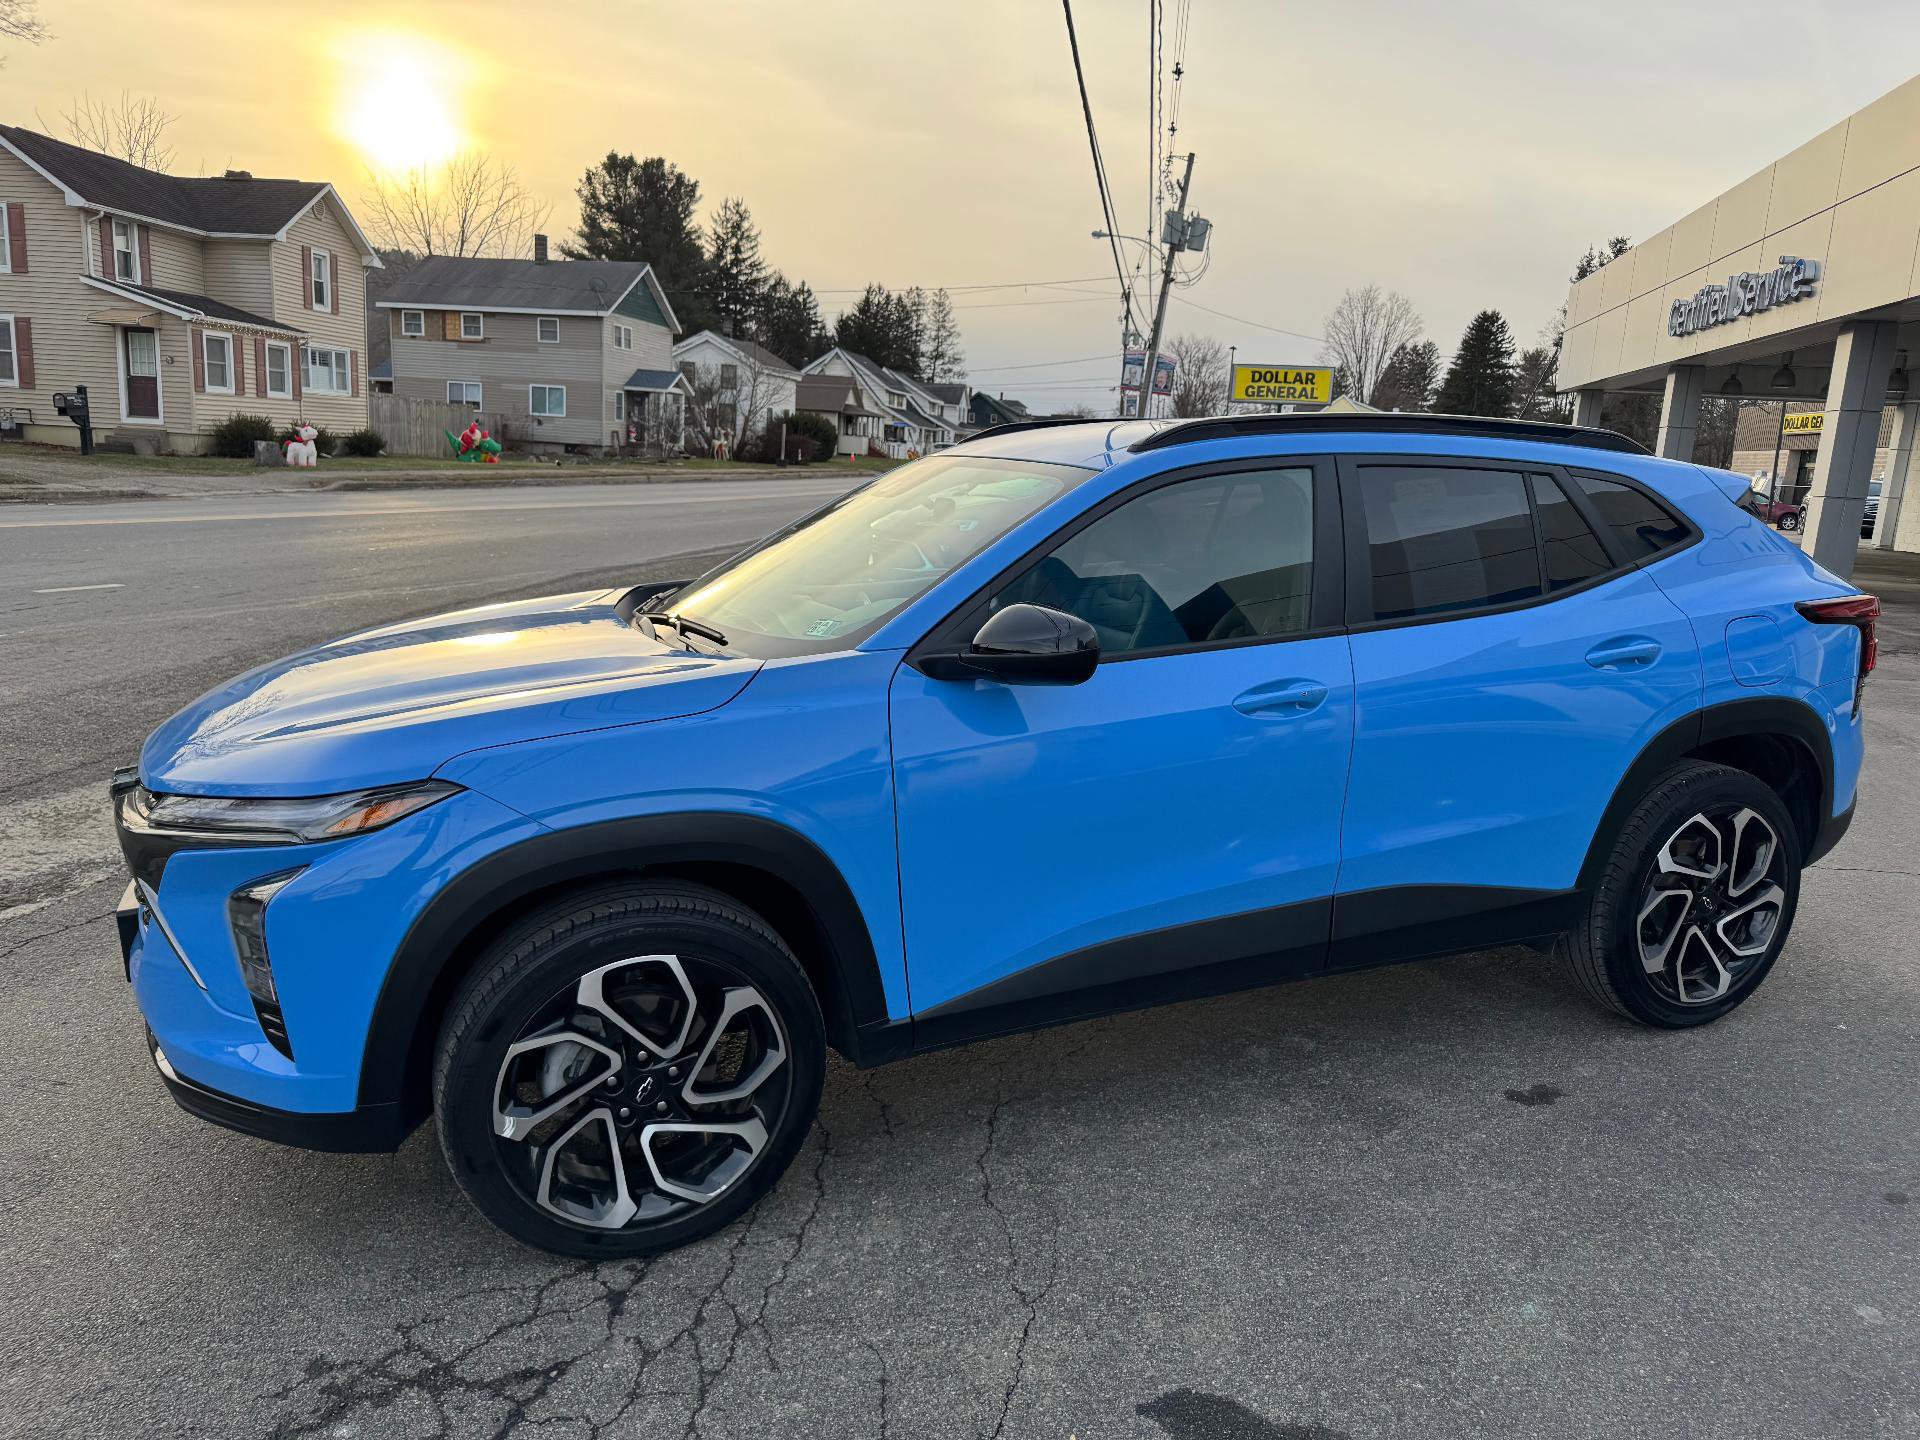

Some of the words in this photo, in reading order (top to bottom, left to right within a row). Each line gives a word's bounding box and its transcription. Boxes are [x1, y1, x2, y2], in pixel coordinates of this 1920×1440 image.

[1668, 275, 1734, 337] Certified
[1733, 263, 1805, 318] Service
[1251, 370, 1316, 385] DOLLAR
[1245, 385, 1318, 399] GENERAL
[1784, 417, 1809, 430] DOLLAR
